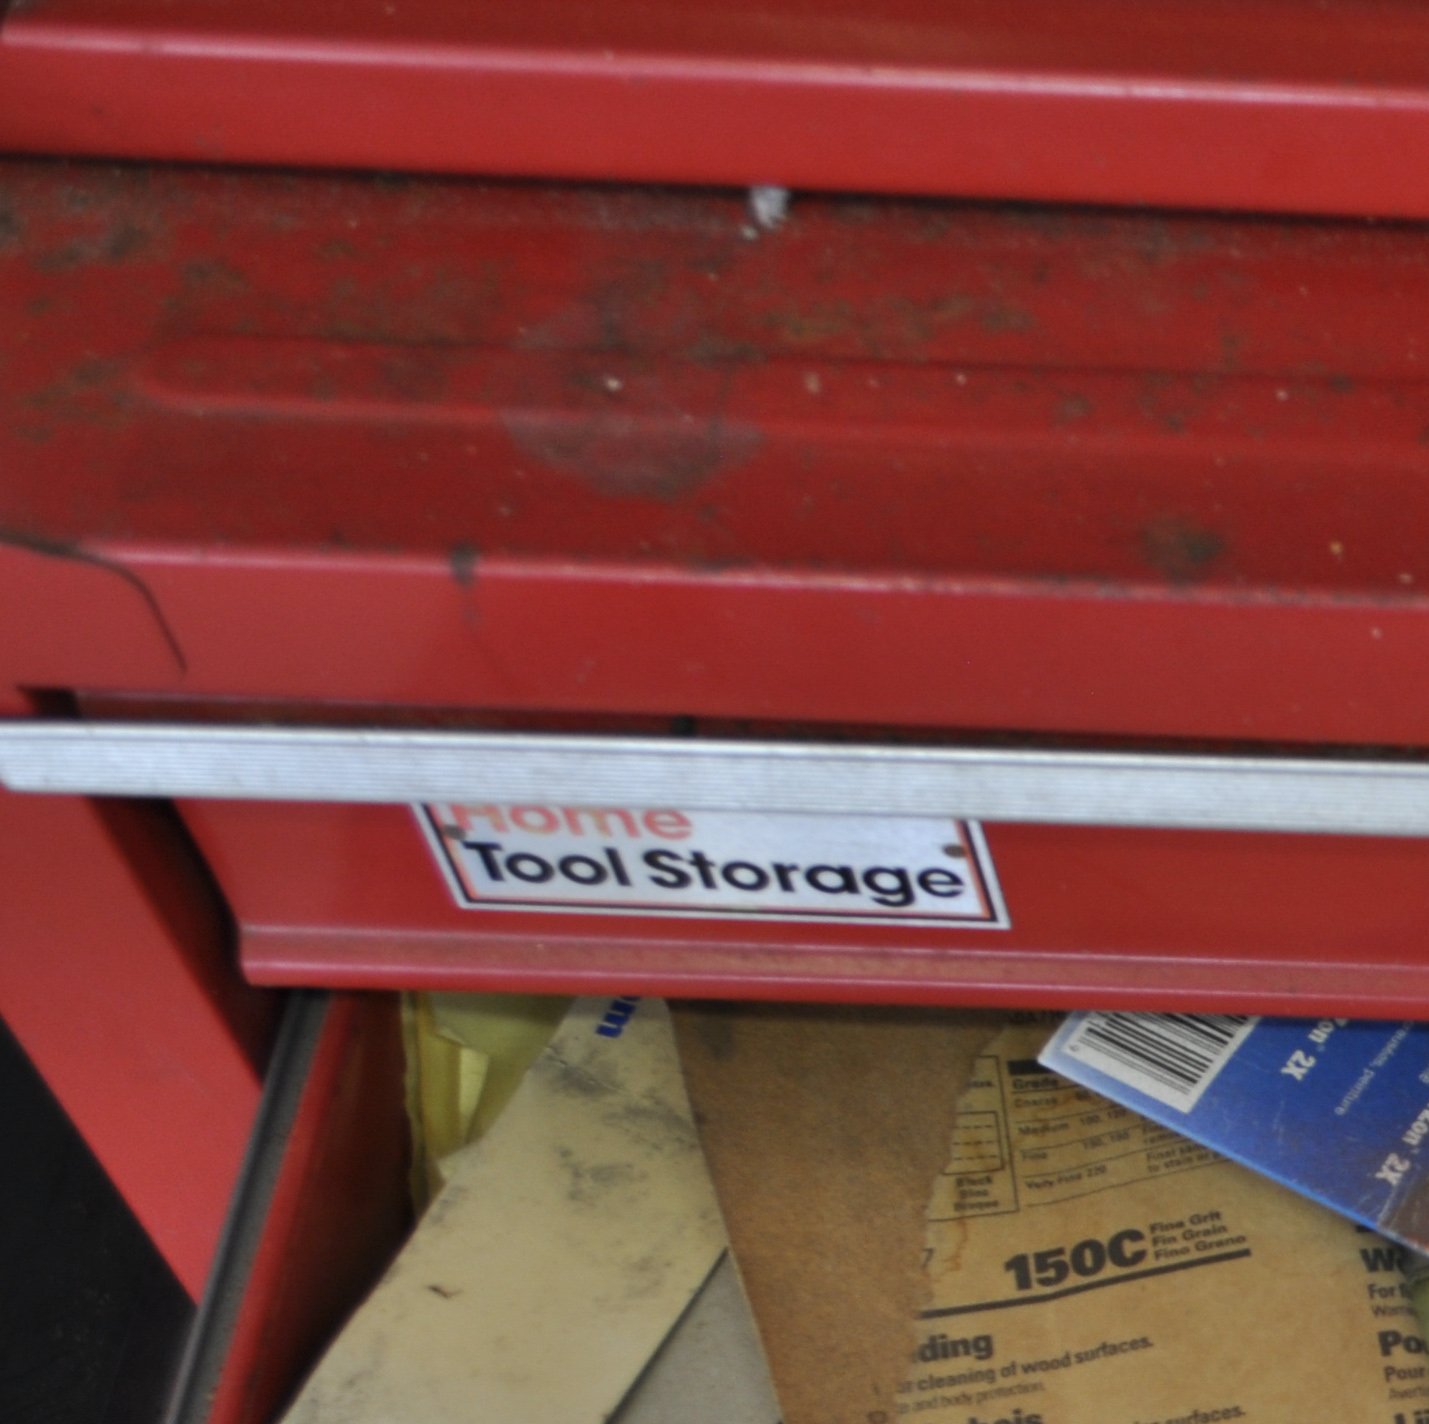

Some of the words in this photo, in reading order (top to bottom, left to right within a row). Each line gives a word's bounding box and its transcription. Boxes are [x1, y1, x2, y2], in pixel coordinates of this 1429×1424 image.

[461, 839, 632, 891] Tool
[641, 848, 966, 907] Storage
[1281, 1050, 1316, 1082] 2X
[1375, 1153, 1411, 1186] 2X
[1150, 1220, 1185, 1234] Fine
[1004, 1228, 1148, 1291] 150C
[914, 1332, 995, 1364] ding
[917, 1366, 996, 1392] cleaning
[1000, 1362, 1018, 1378] of
[1021, 1352, 1072, 1375] wood
[1074, 1336, 1153, 1365] surfaces.
[1384, 1366, 1426, 1382] Pour
